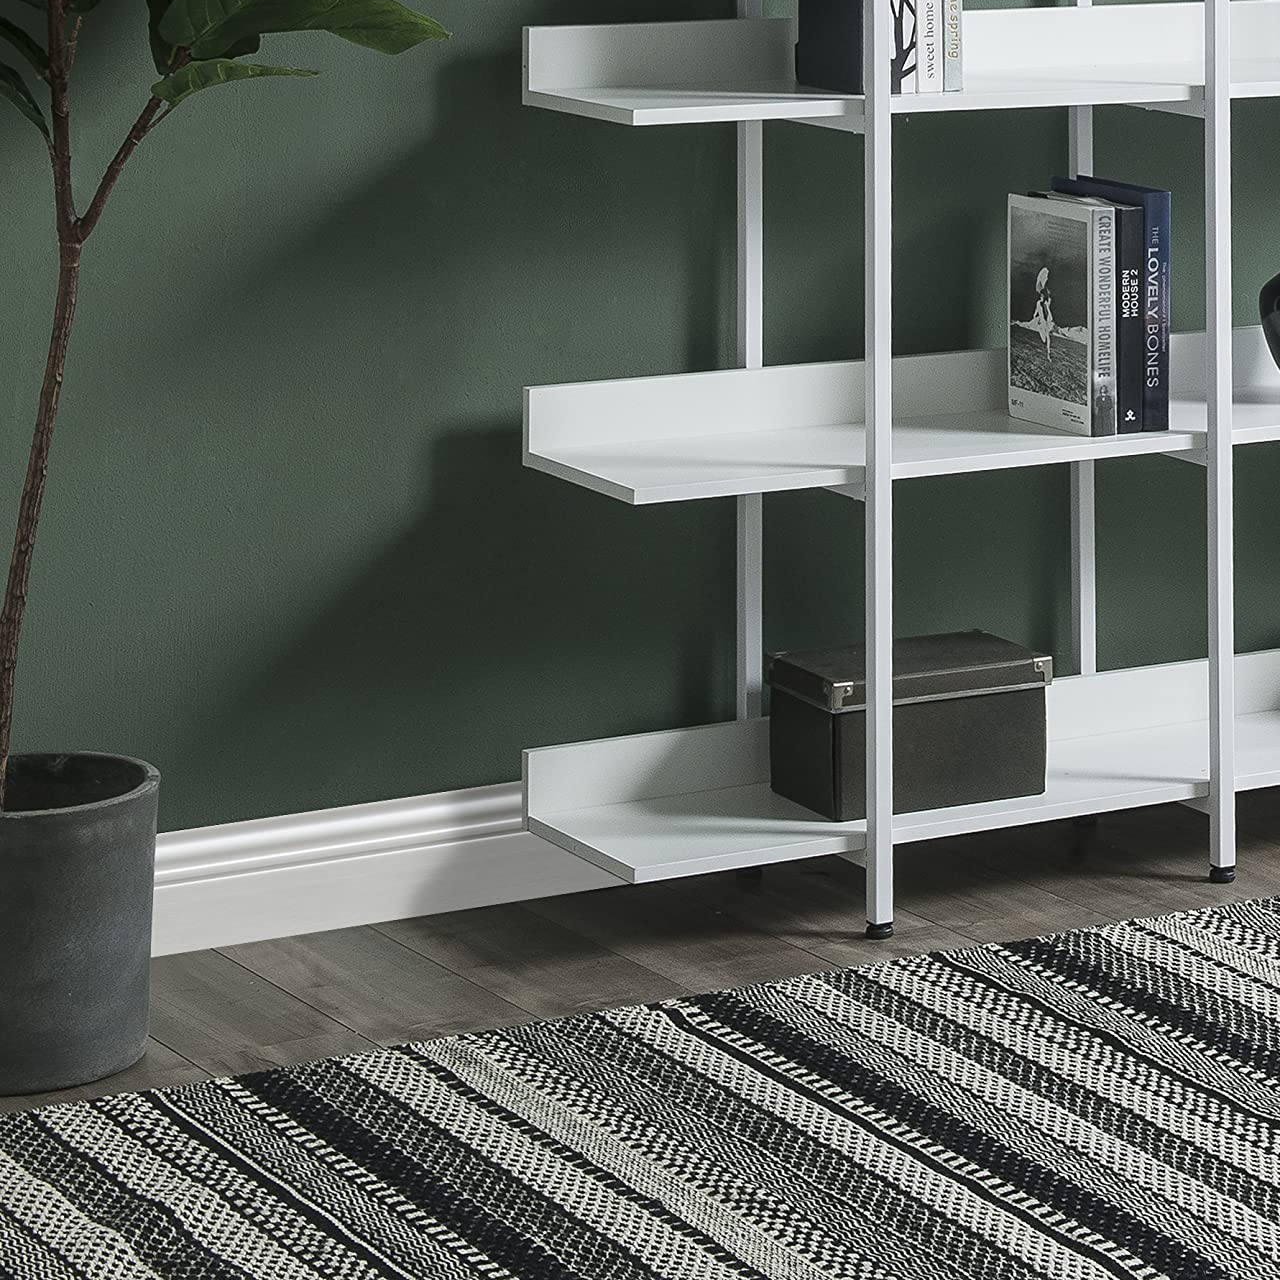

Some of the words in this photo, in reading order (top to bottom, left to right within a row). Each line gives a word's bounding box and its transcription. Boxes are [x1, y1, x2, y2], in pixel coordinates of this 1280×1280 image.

[927, 42, 935, 79] sweet
[948, 15, 960, 59] spring
[1098, 215, 1112, 253] CREATE
[1098, 256, 1112, 322] WONDERFUL
[1122, 270, 1130, 318] MODERN
[1147, 248, 1159, 320] LOVELY
[1098, 326, 1112, 378] HOMELIFE
[1146, 324, 1159, 388] BONES
